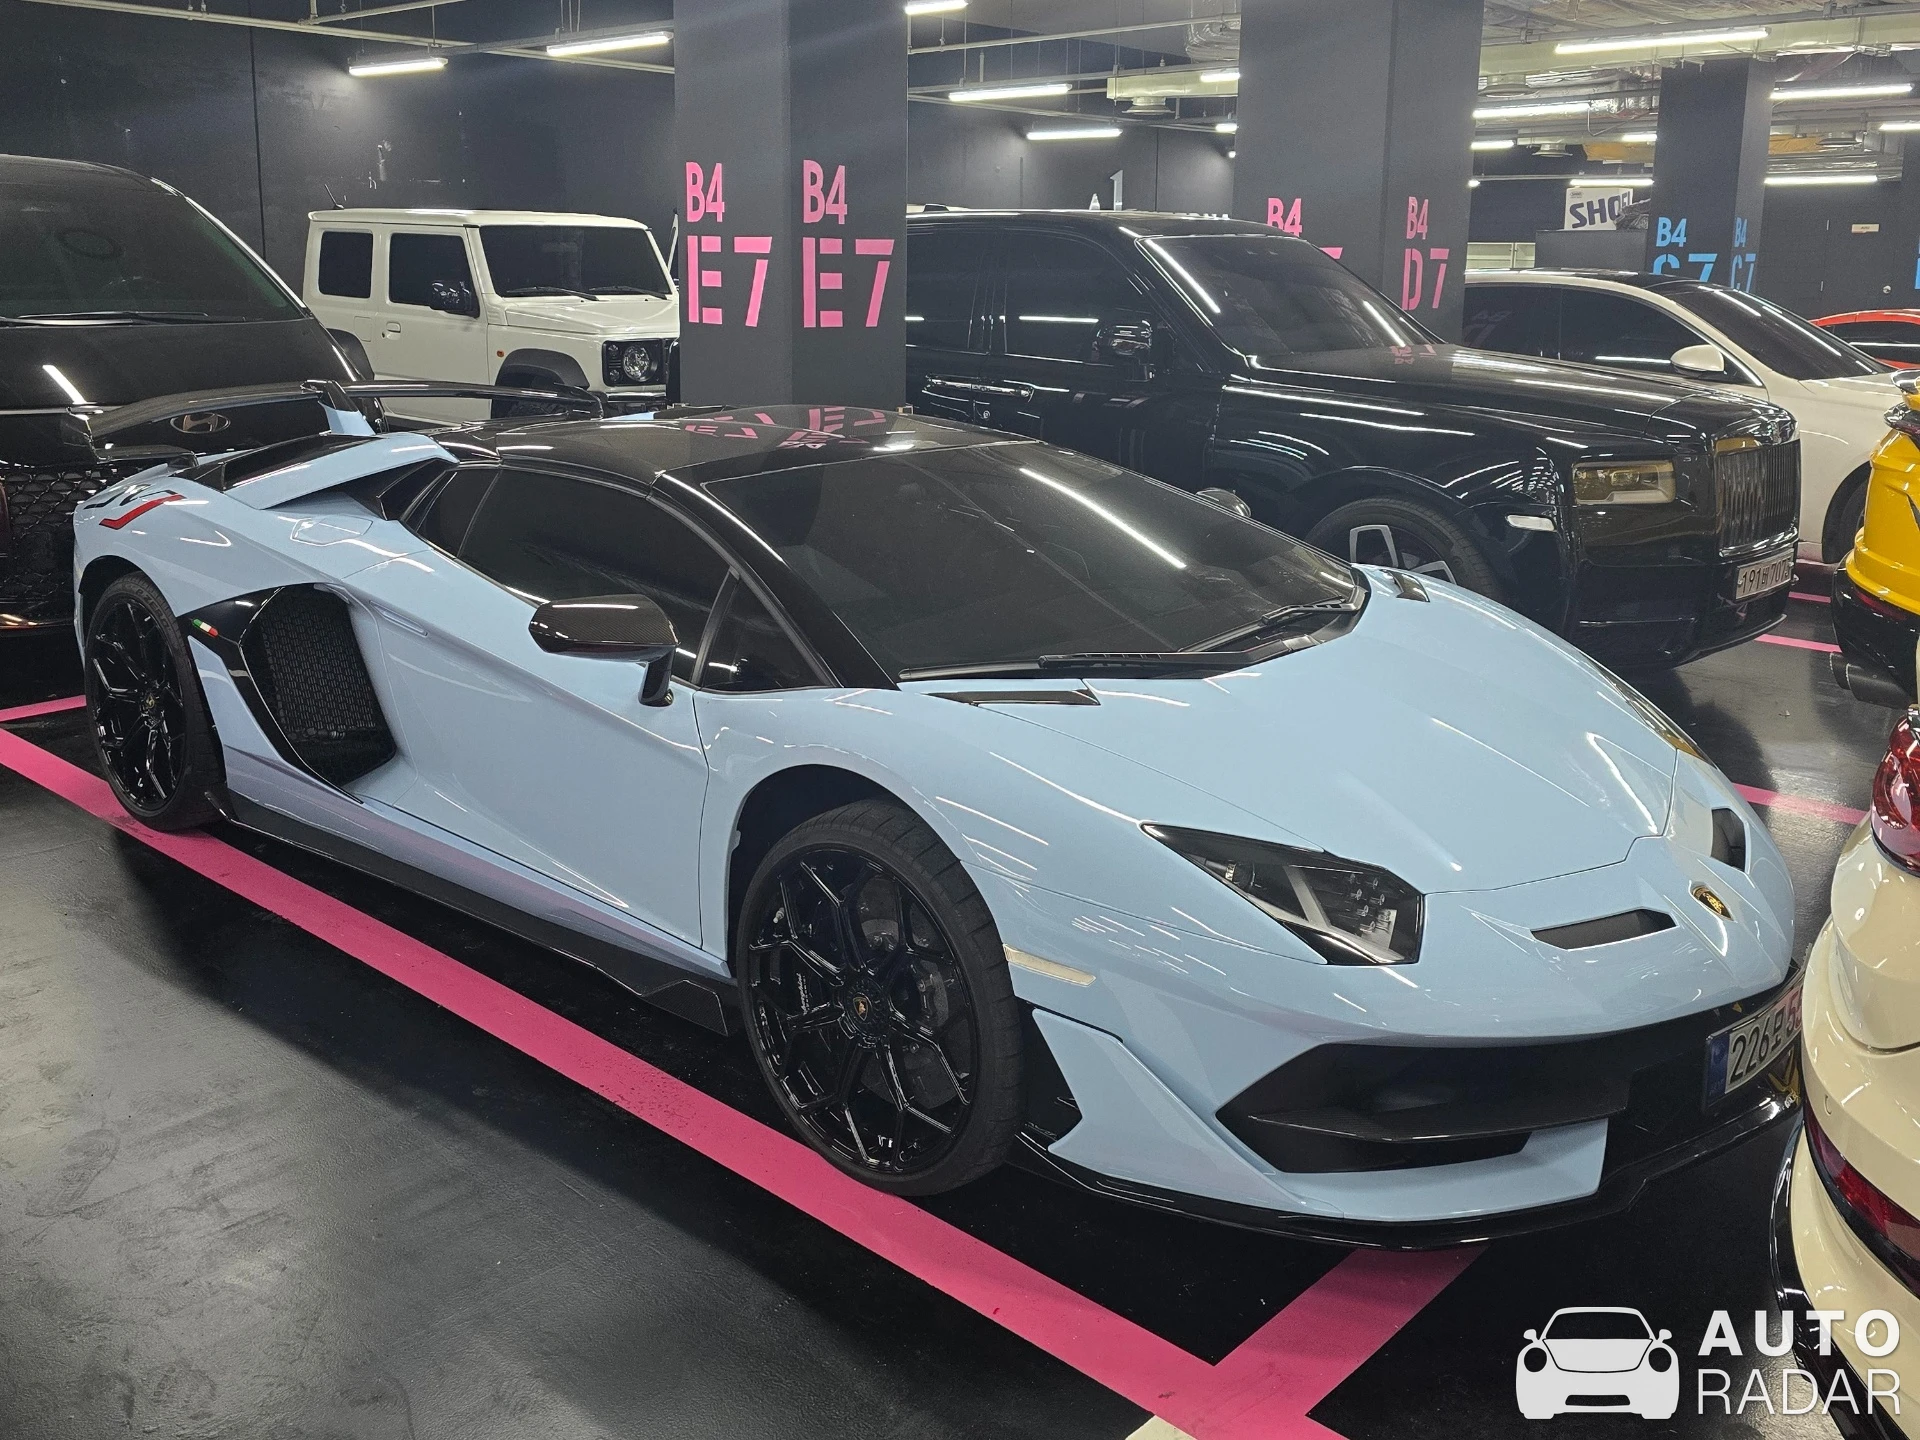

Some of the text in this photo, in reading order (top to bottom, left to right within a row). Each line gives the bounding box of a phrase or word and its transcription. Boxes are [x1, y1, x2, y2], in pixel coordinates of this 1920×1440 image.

[686, 162, 725, 222] B4
[803, 159, 848, 225] B4
[1267, 197, 1303, 237] B4
[1406, 196, 1428, 240] B4
[1656, 217, 1687, 248] B4
[1733, 217, 1748, 248] B4
[687, 236, 773, 328] E7
[803, 237, 895, 328] E7
[1401, 248, 1450, 311] D7
